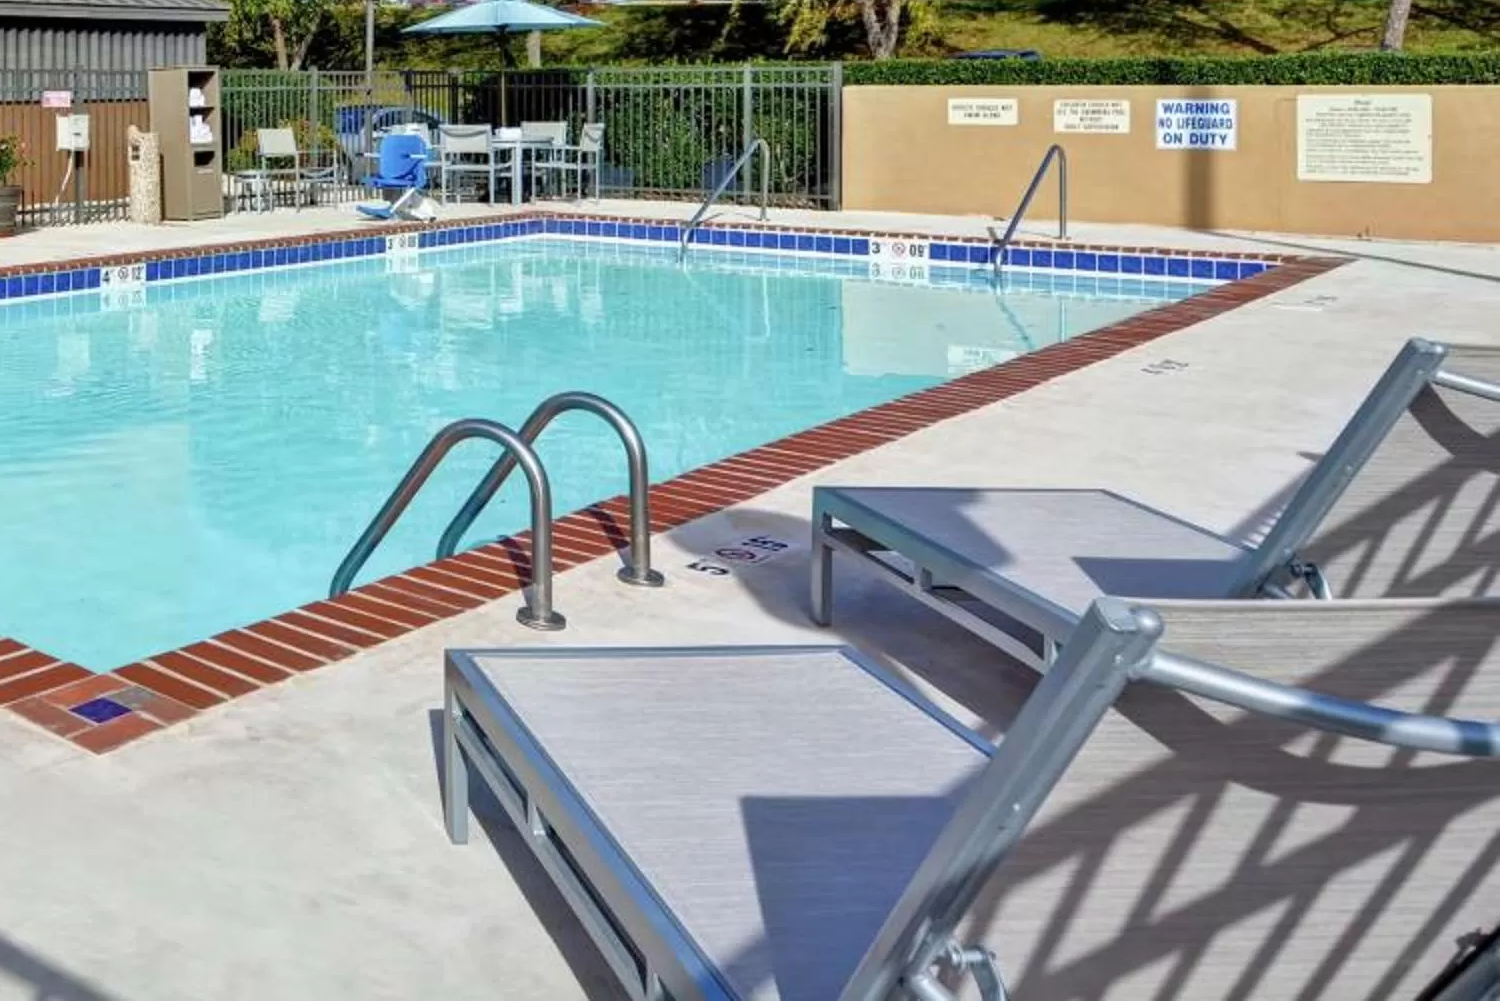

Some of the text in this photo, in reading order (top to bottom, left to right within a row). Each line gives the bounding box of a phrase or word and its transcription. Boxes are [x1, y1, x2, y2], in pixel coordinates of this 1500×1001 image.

[1162, 102, 1231, 115] WARNING
[1158, 117, 1233, 130] NO LIFEGUARD
[1163, 132, 1228, 145] ON DUTY
